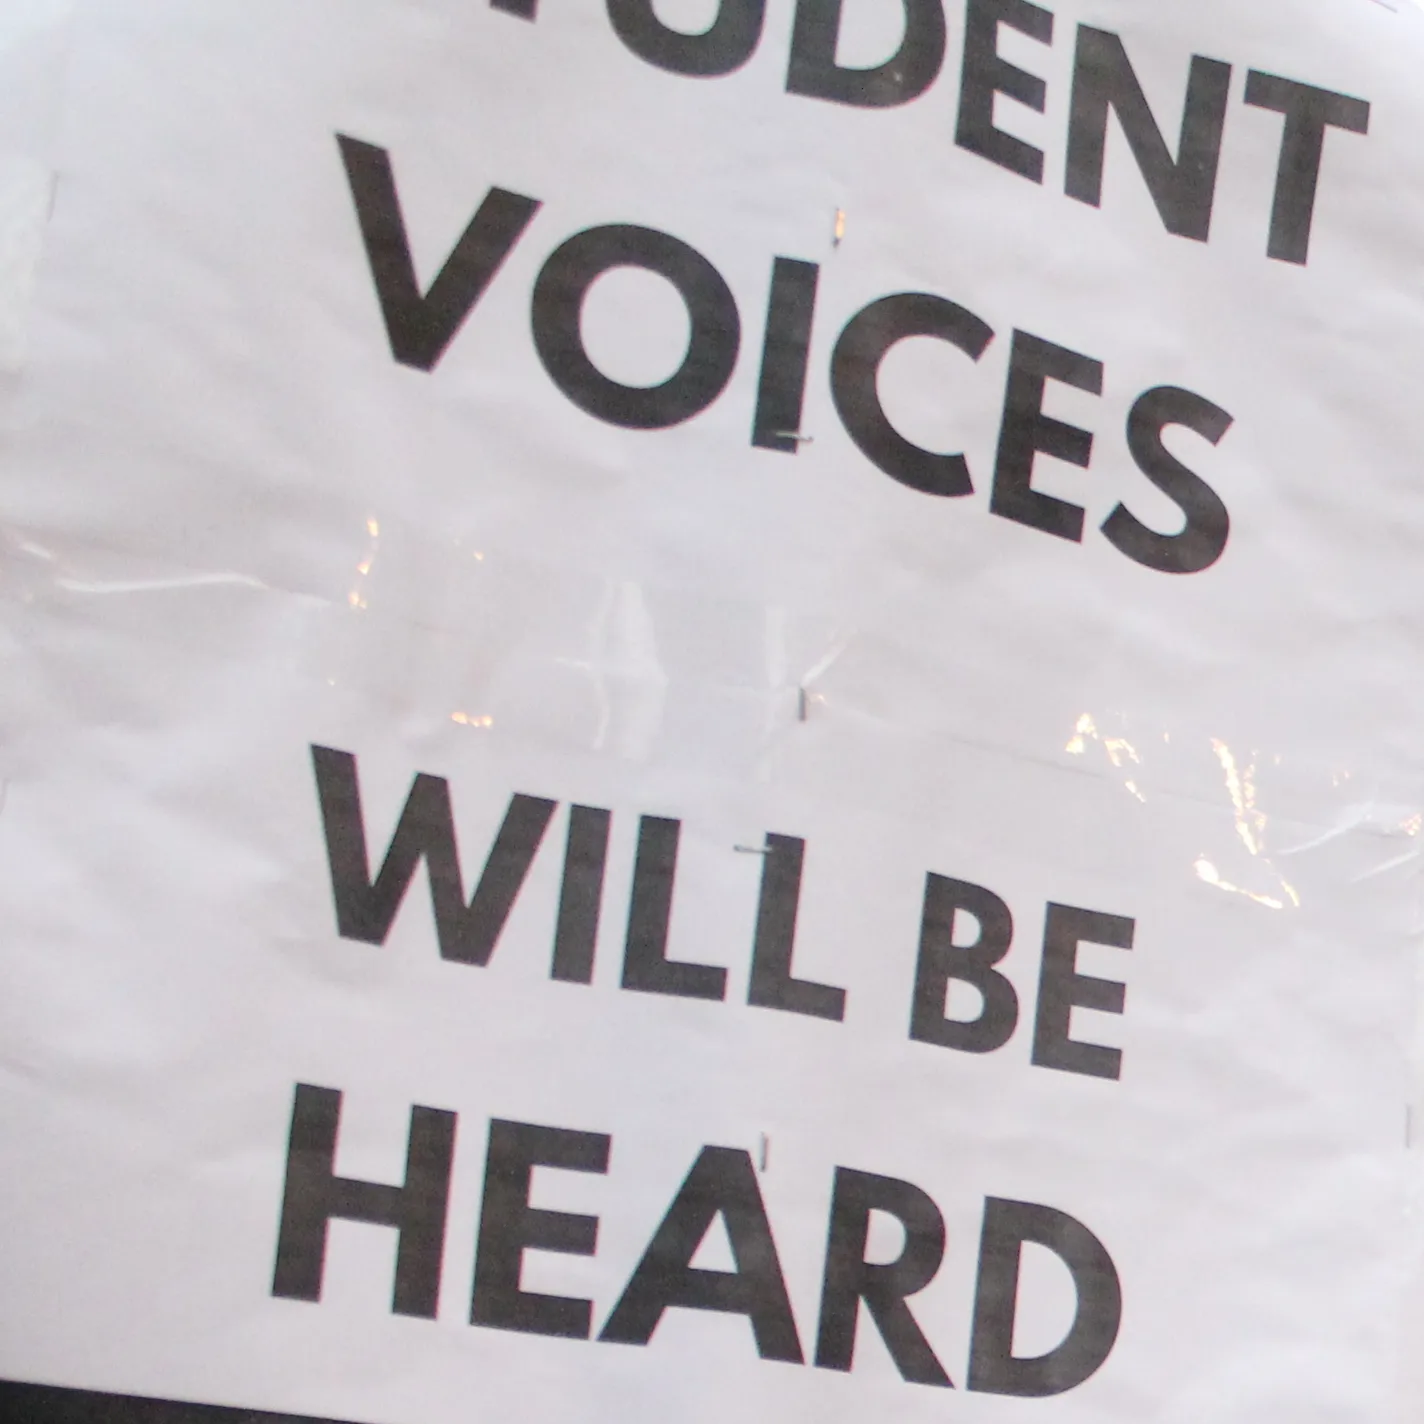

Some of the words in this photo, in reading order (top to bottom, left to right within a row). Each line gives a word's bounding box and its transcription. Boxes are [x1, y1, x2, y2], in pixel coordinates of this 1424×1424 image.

[335, 132, 1234, 574] VOICES
[310, 744, 846, 1022] WILL
[908, 870, 1136, 1081] BE
[270, 1081, 1123, 1400] HEARD
